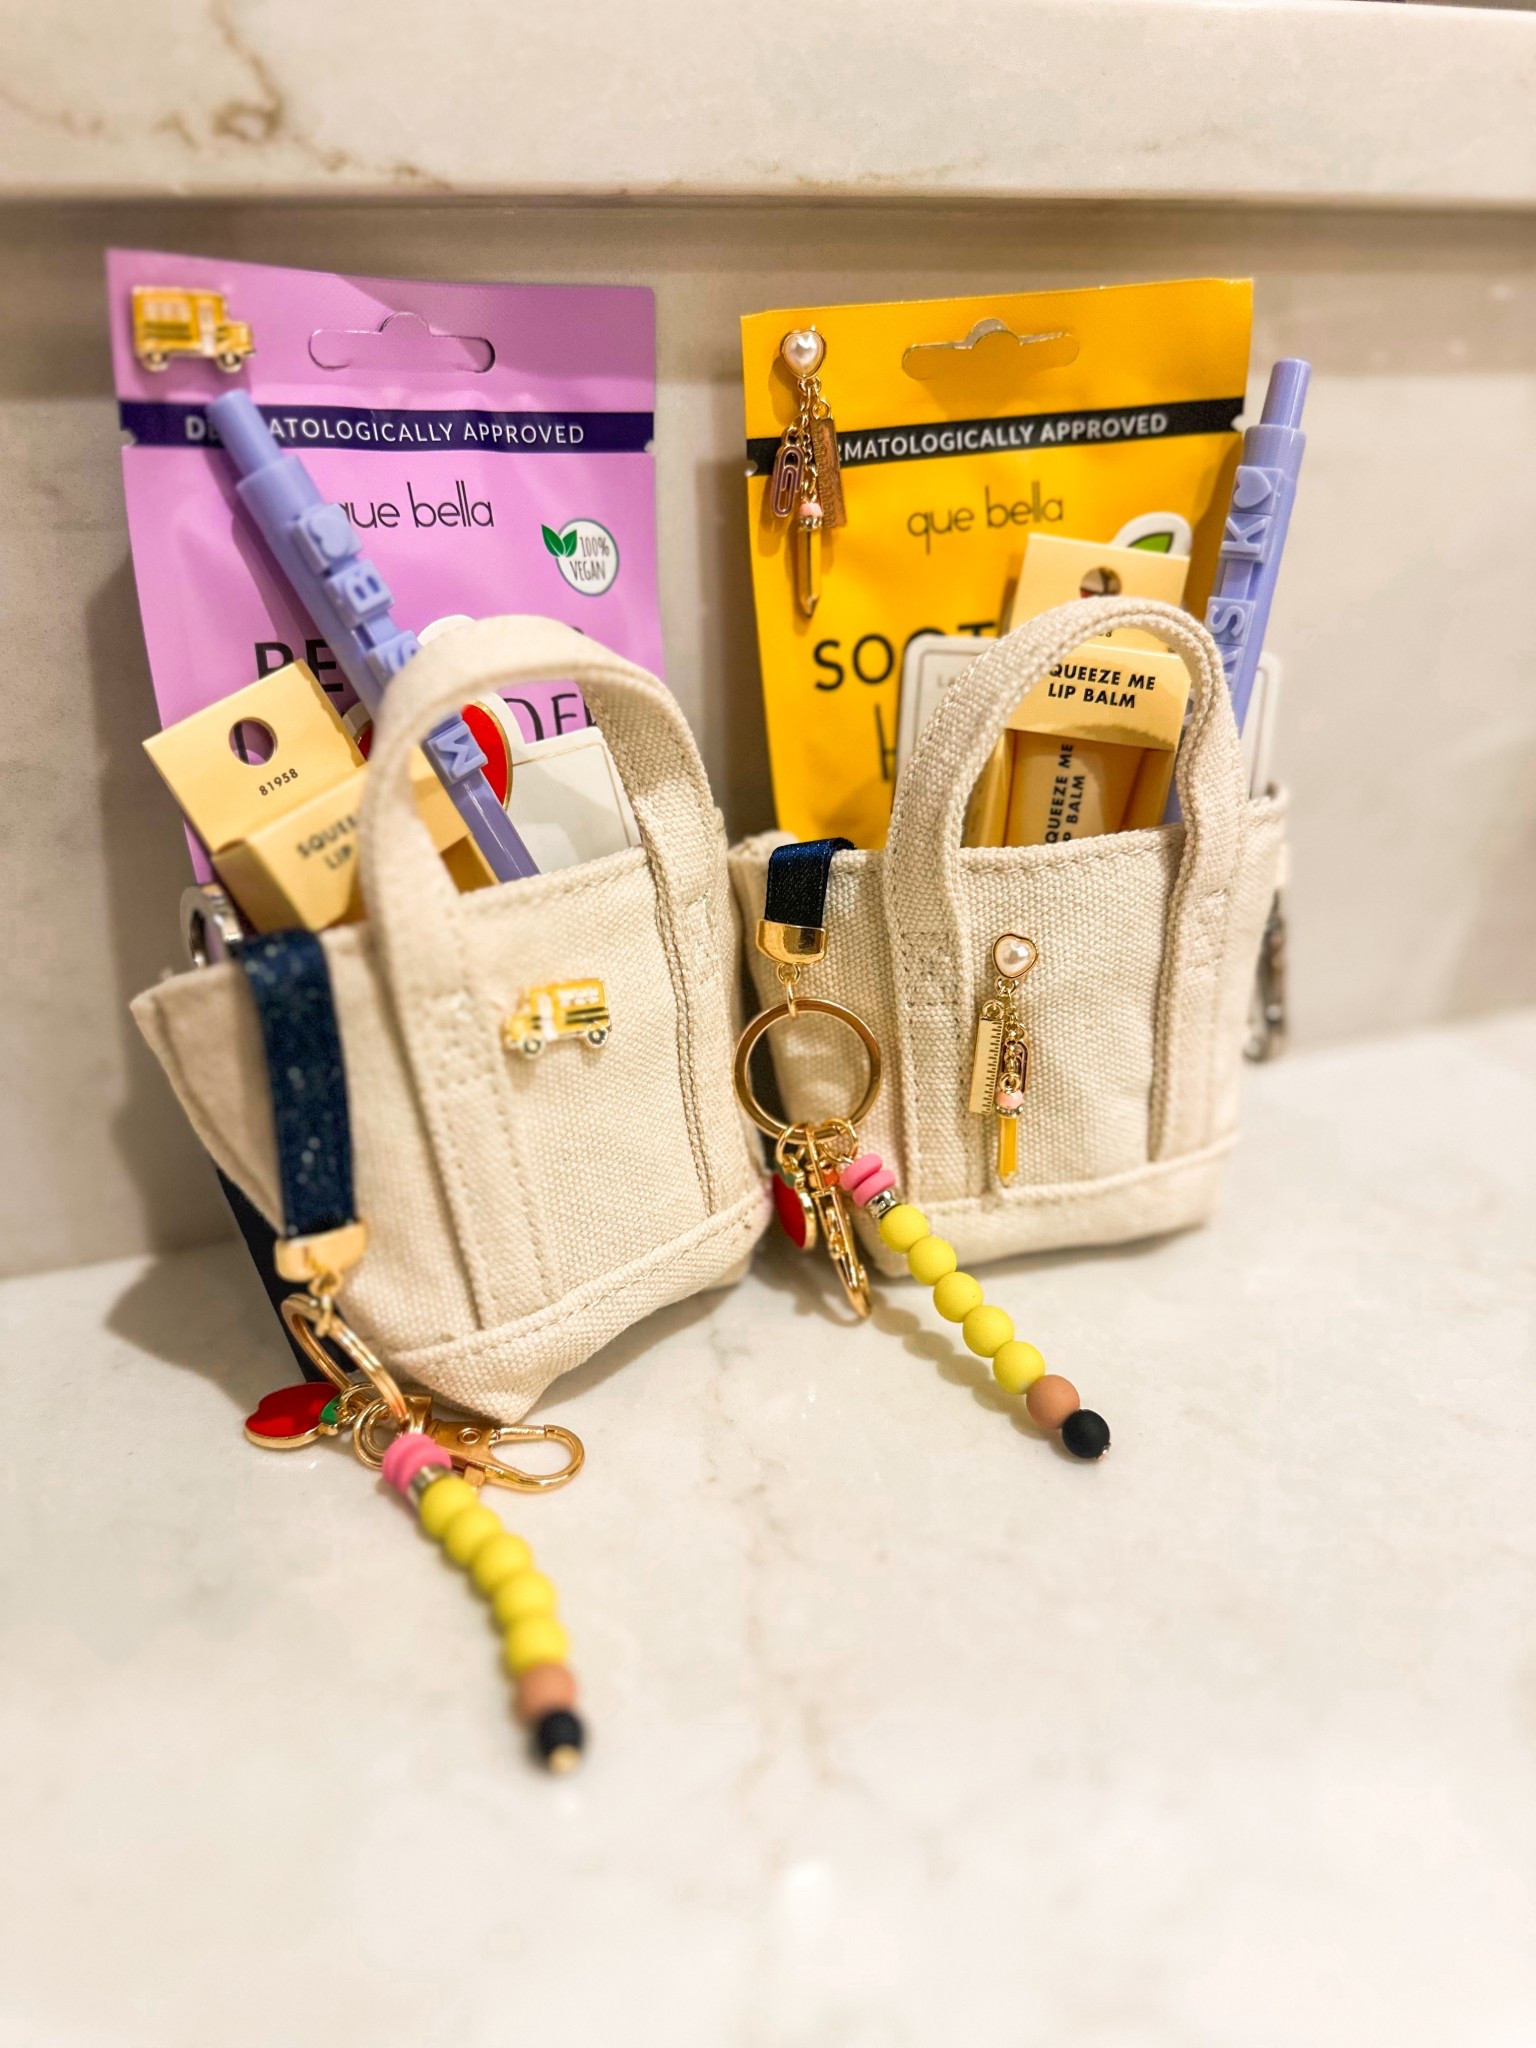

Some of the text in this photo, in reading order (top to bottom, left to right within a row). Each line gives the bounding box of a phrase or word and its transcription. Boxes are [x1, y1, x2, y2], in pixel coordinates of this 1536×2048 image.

[185, 415, 584, 444] DATOLOGICALLY APPROVED
[837, 413, 1167, 461] MATOLOGICALLY APPROVED
[344, 480, 495, 529] ue bella
[907, 481, 1064, 556] que bella
[579, 536, 610, 558] 100%
[569, 560, 606, 582] VEGAN
[1048, 663, 1156, 691] QUEEZE ME
[1048, 683, 1136, 709] LIP BALM
[258, 768, 299, 796] 81958
[1045, 775, 1068, 845] QUEEZE
[1058, 743, 1074, 769] ME
[1065, 775, 1086, 825] BALM
